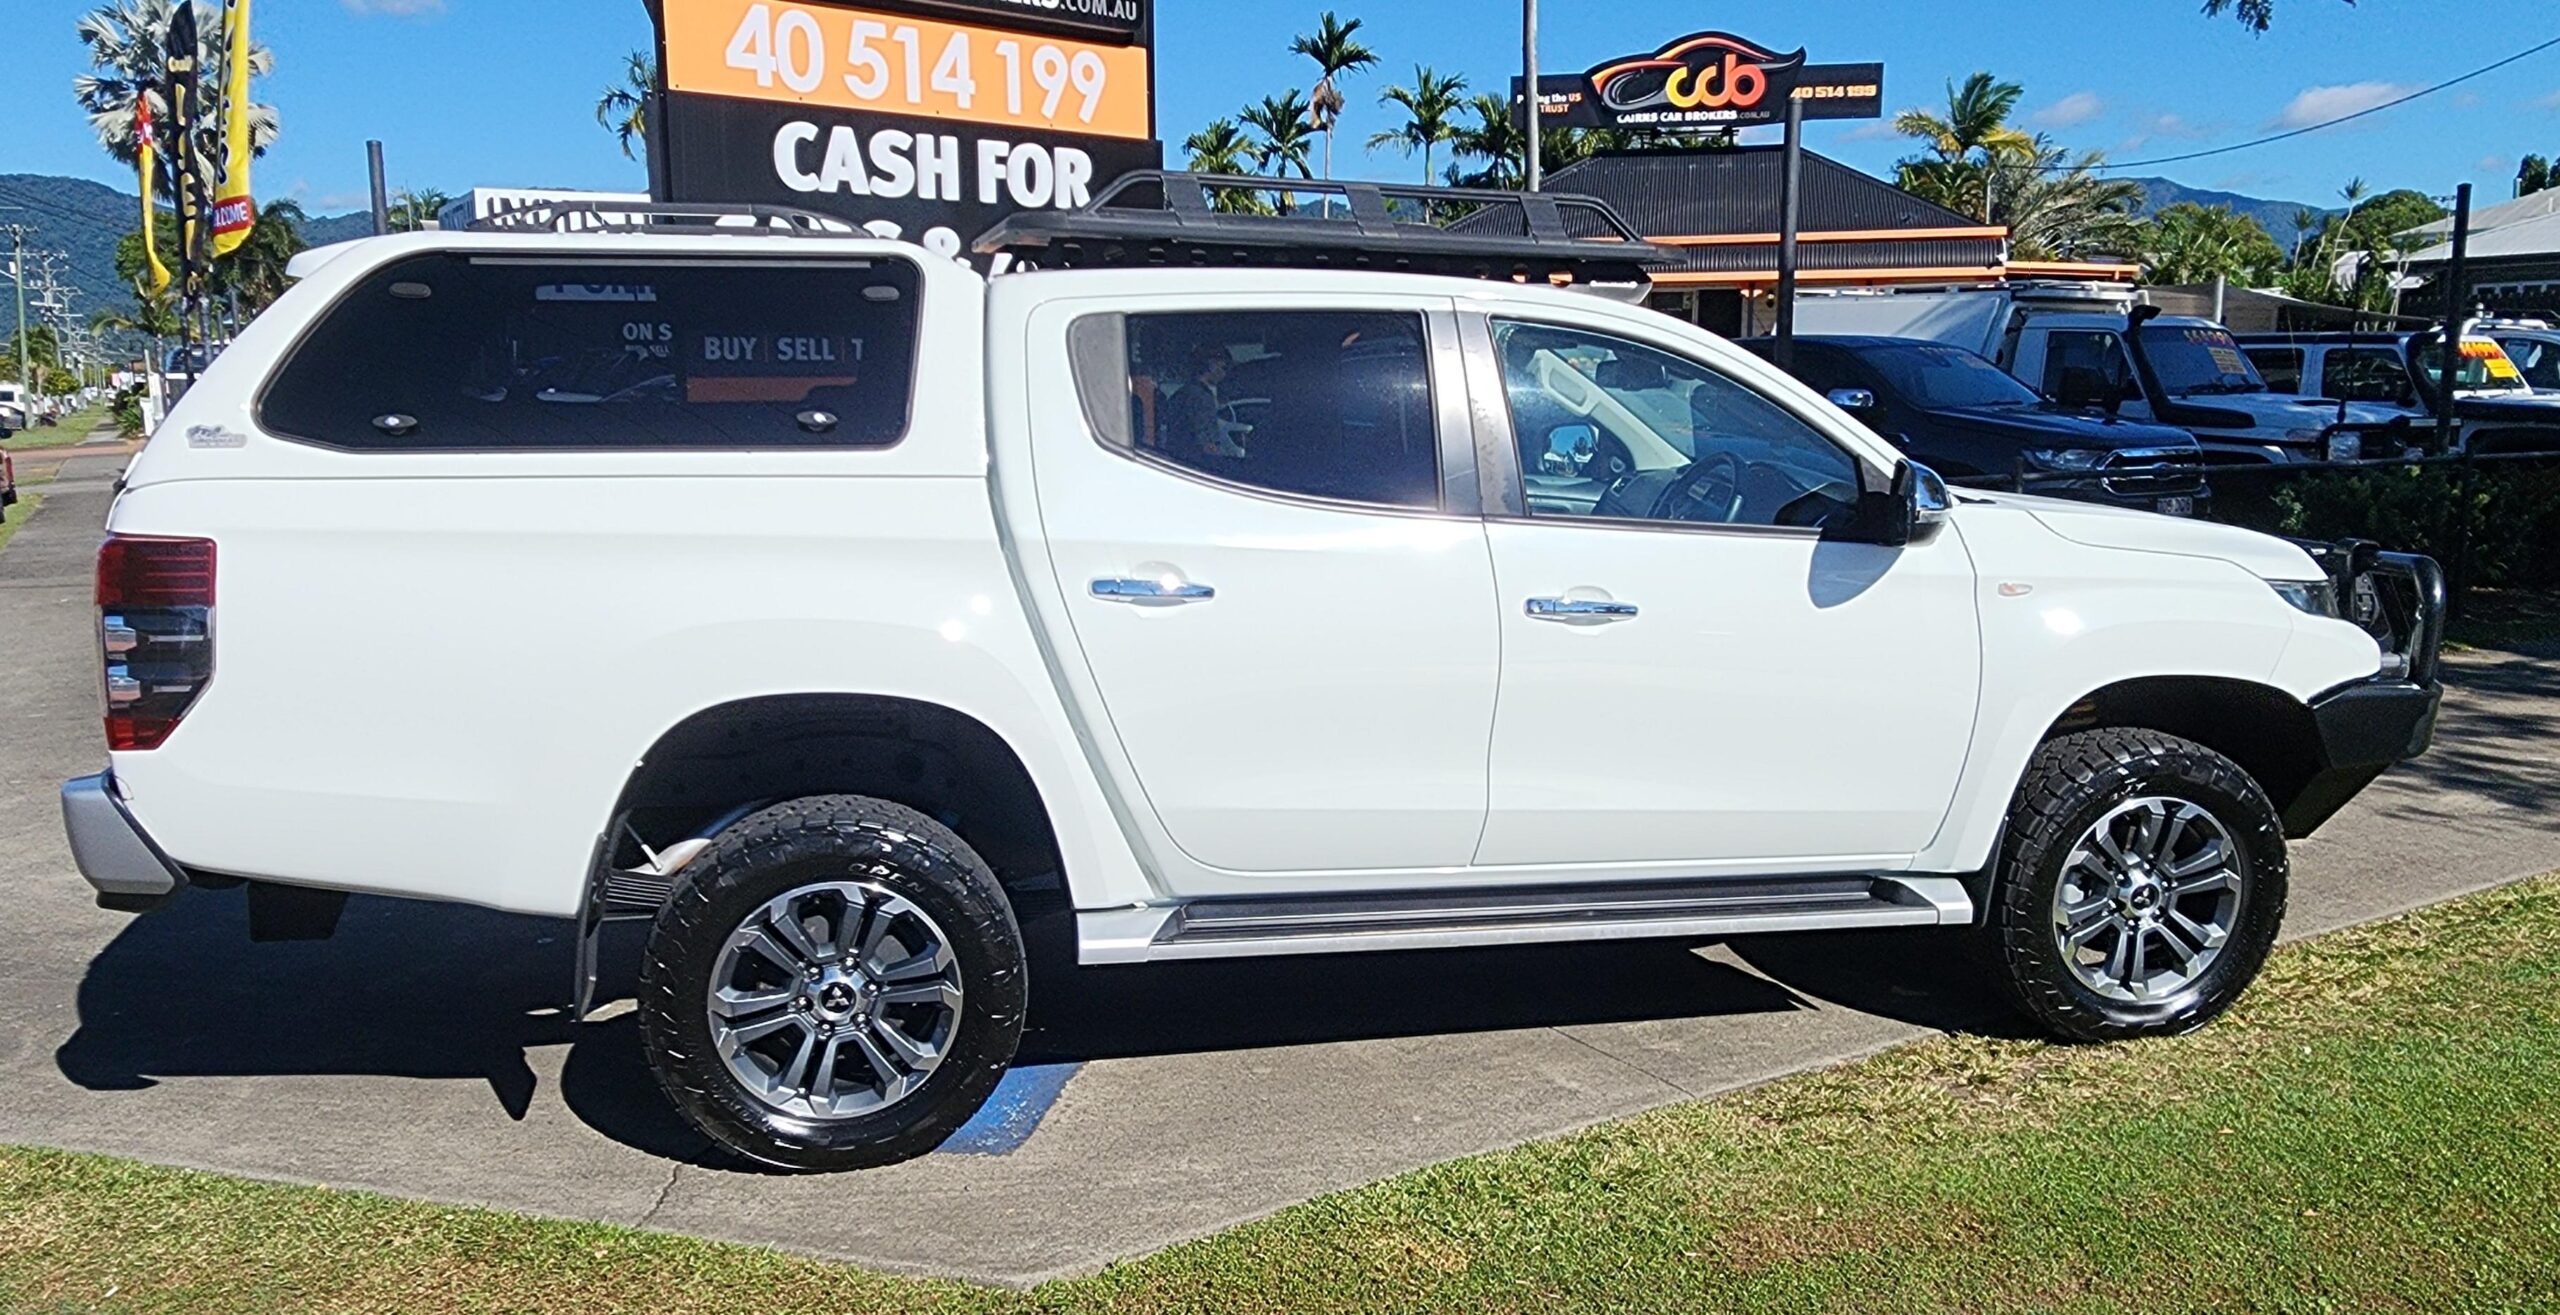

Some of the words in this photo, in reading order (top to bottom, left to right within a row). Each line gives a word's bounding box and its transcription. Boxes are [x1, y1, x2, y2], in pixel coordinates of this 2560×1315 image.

[725, 4, 825, 94] 40
[843, 19, 976, 110] 514
[995, 39, 1107, 124] 199
[1568, 92, 1582, 102] US
[1790, 86, 1814, 99] 40
[1815, 85, 1845, 98] 514
[1540, 103, 1570, 113] TRUST
[1616, 112, 1658, 123] CAIRNS
[1660, 111, 1683, 122] CAR
[773, 120, 960, 202] CASH
[976, 138, 1093, 210] FOR
[622, 321, 653, 341] ON
[703, 336, 757, 361] BUY
[776, 336, 836, 361] SELL
